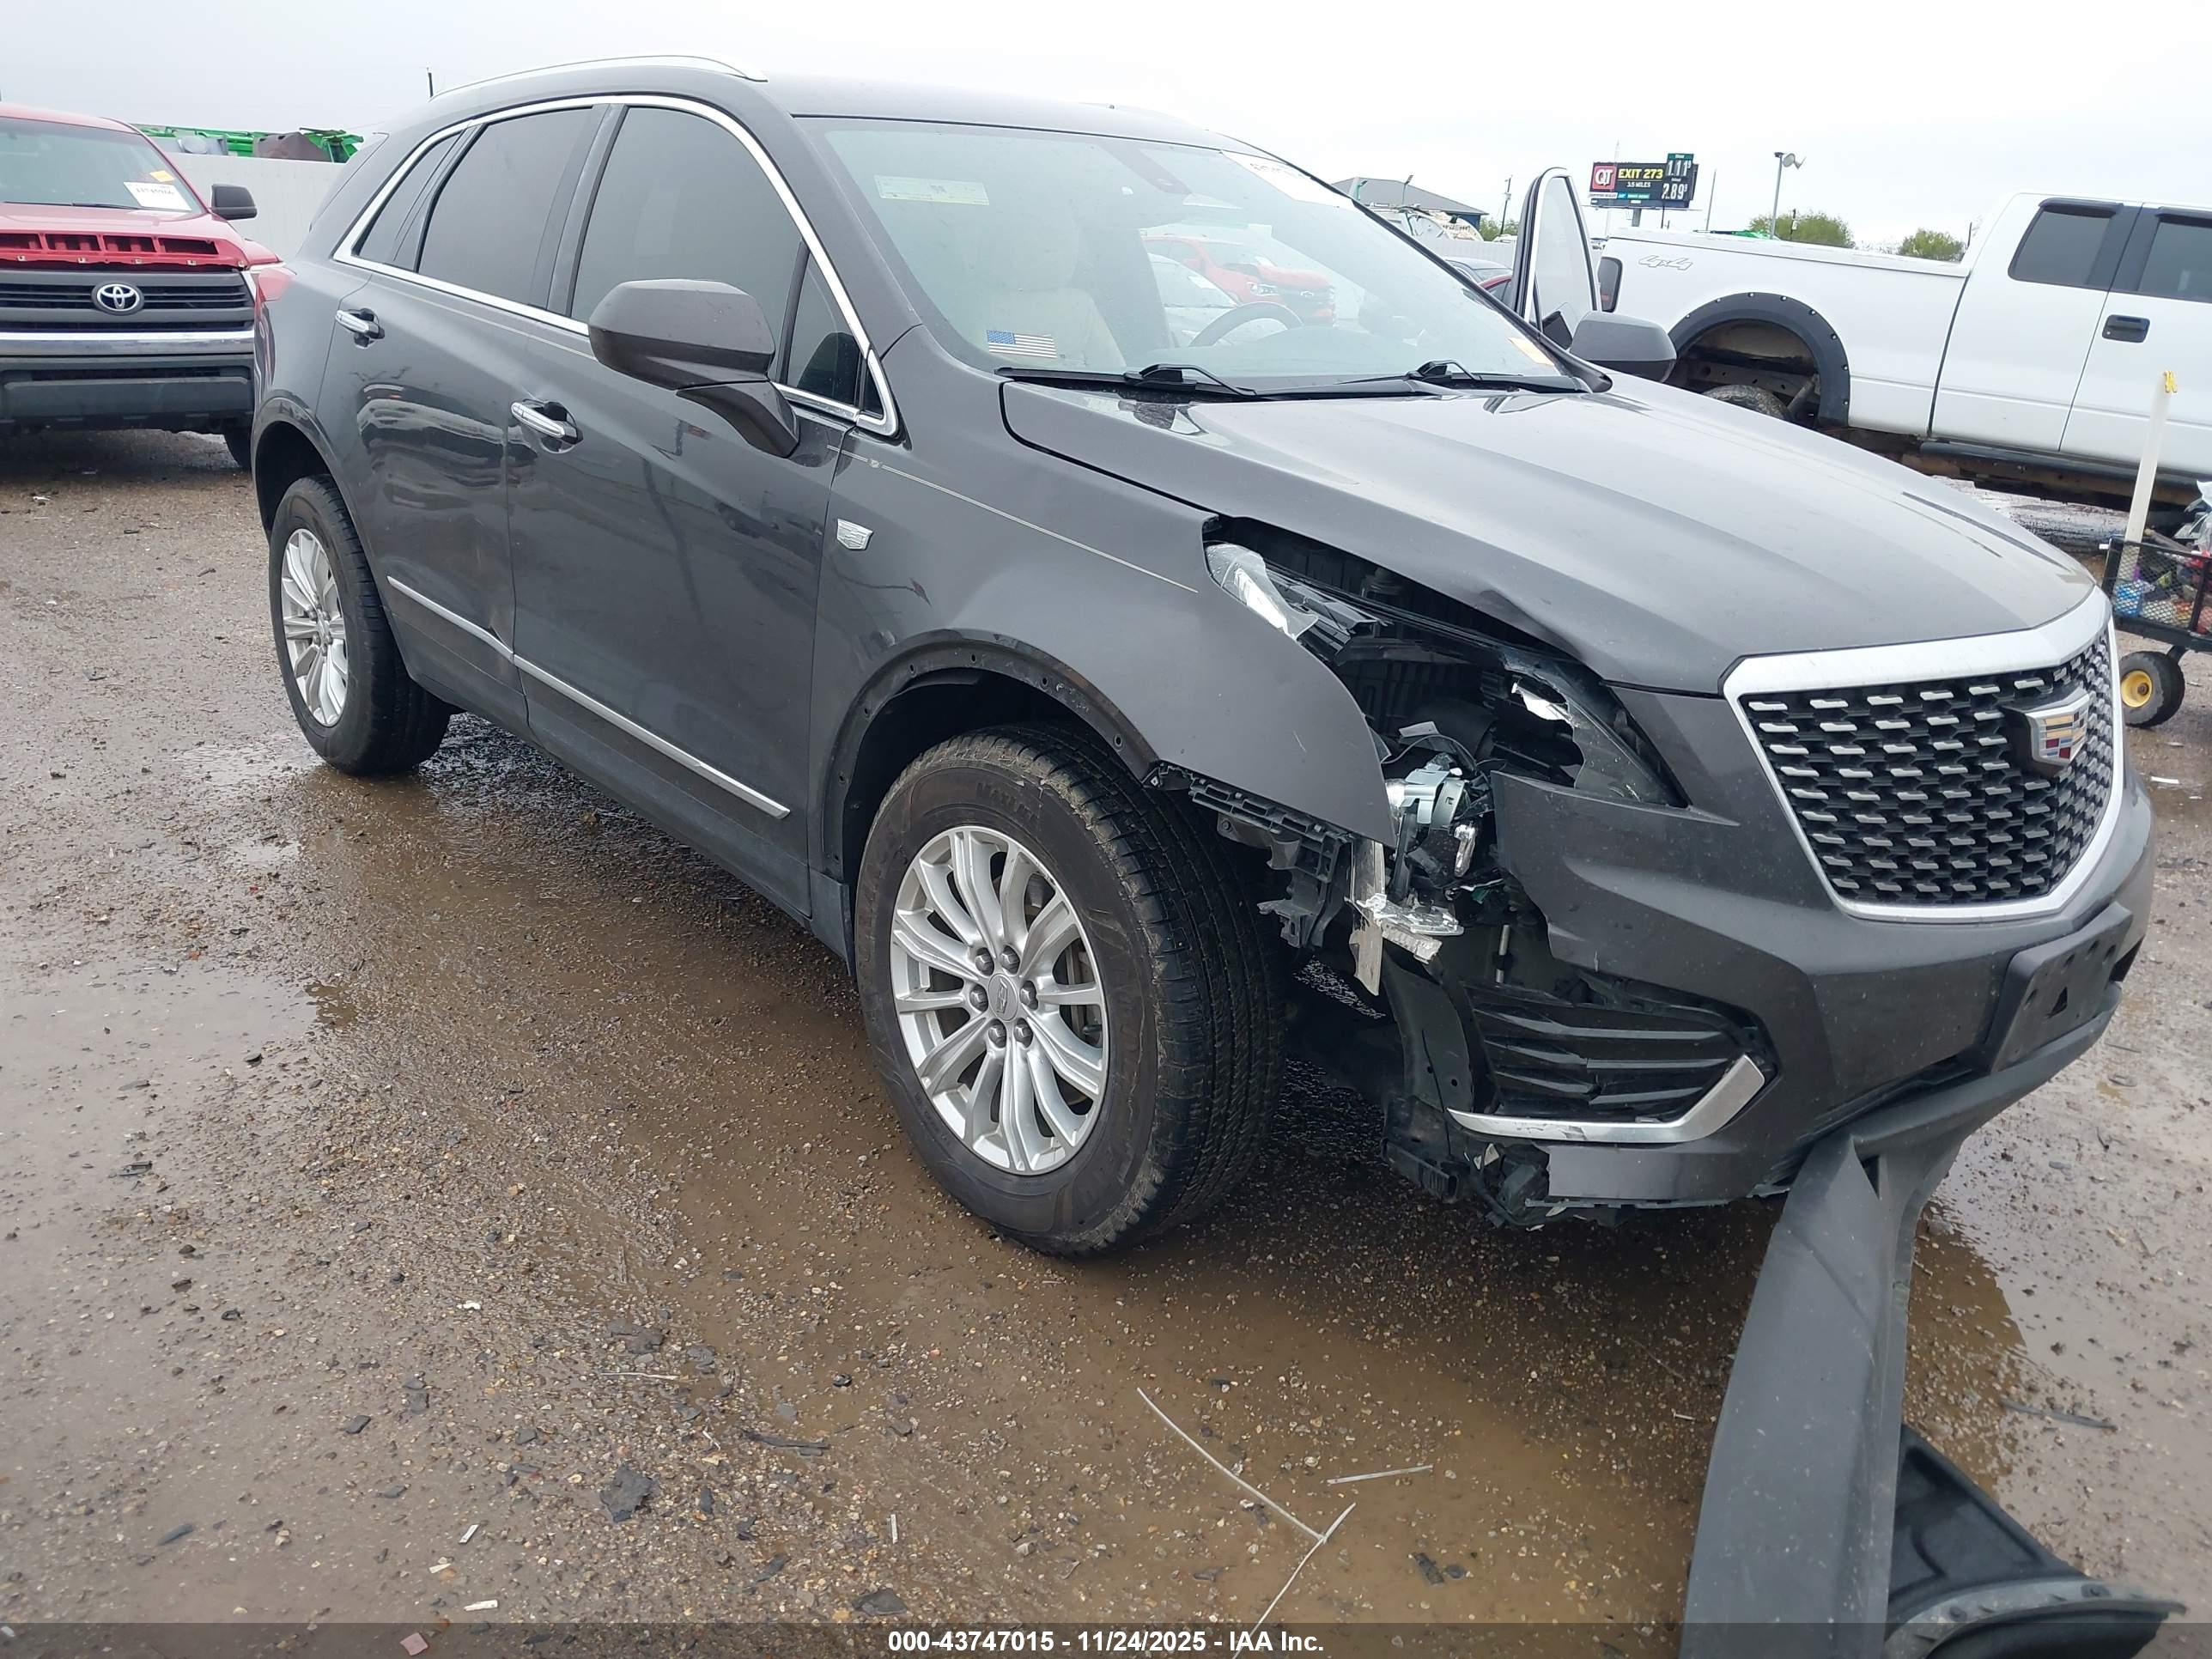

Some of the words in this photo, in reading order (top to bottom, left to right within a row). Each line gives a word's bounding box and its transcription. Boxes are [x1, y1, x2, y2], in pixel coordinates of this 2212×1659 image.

[1595, 169, 1613, 186] QT
[1618, 168, 1641, 179] EXIT
[1644, 168, 1663, 179] 273
[1638, 255, 1693, 270] 4x4
